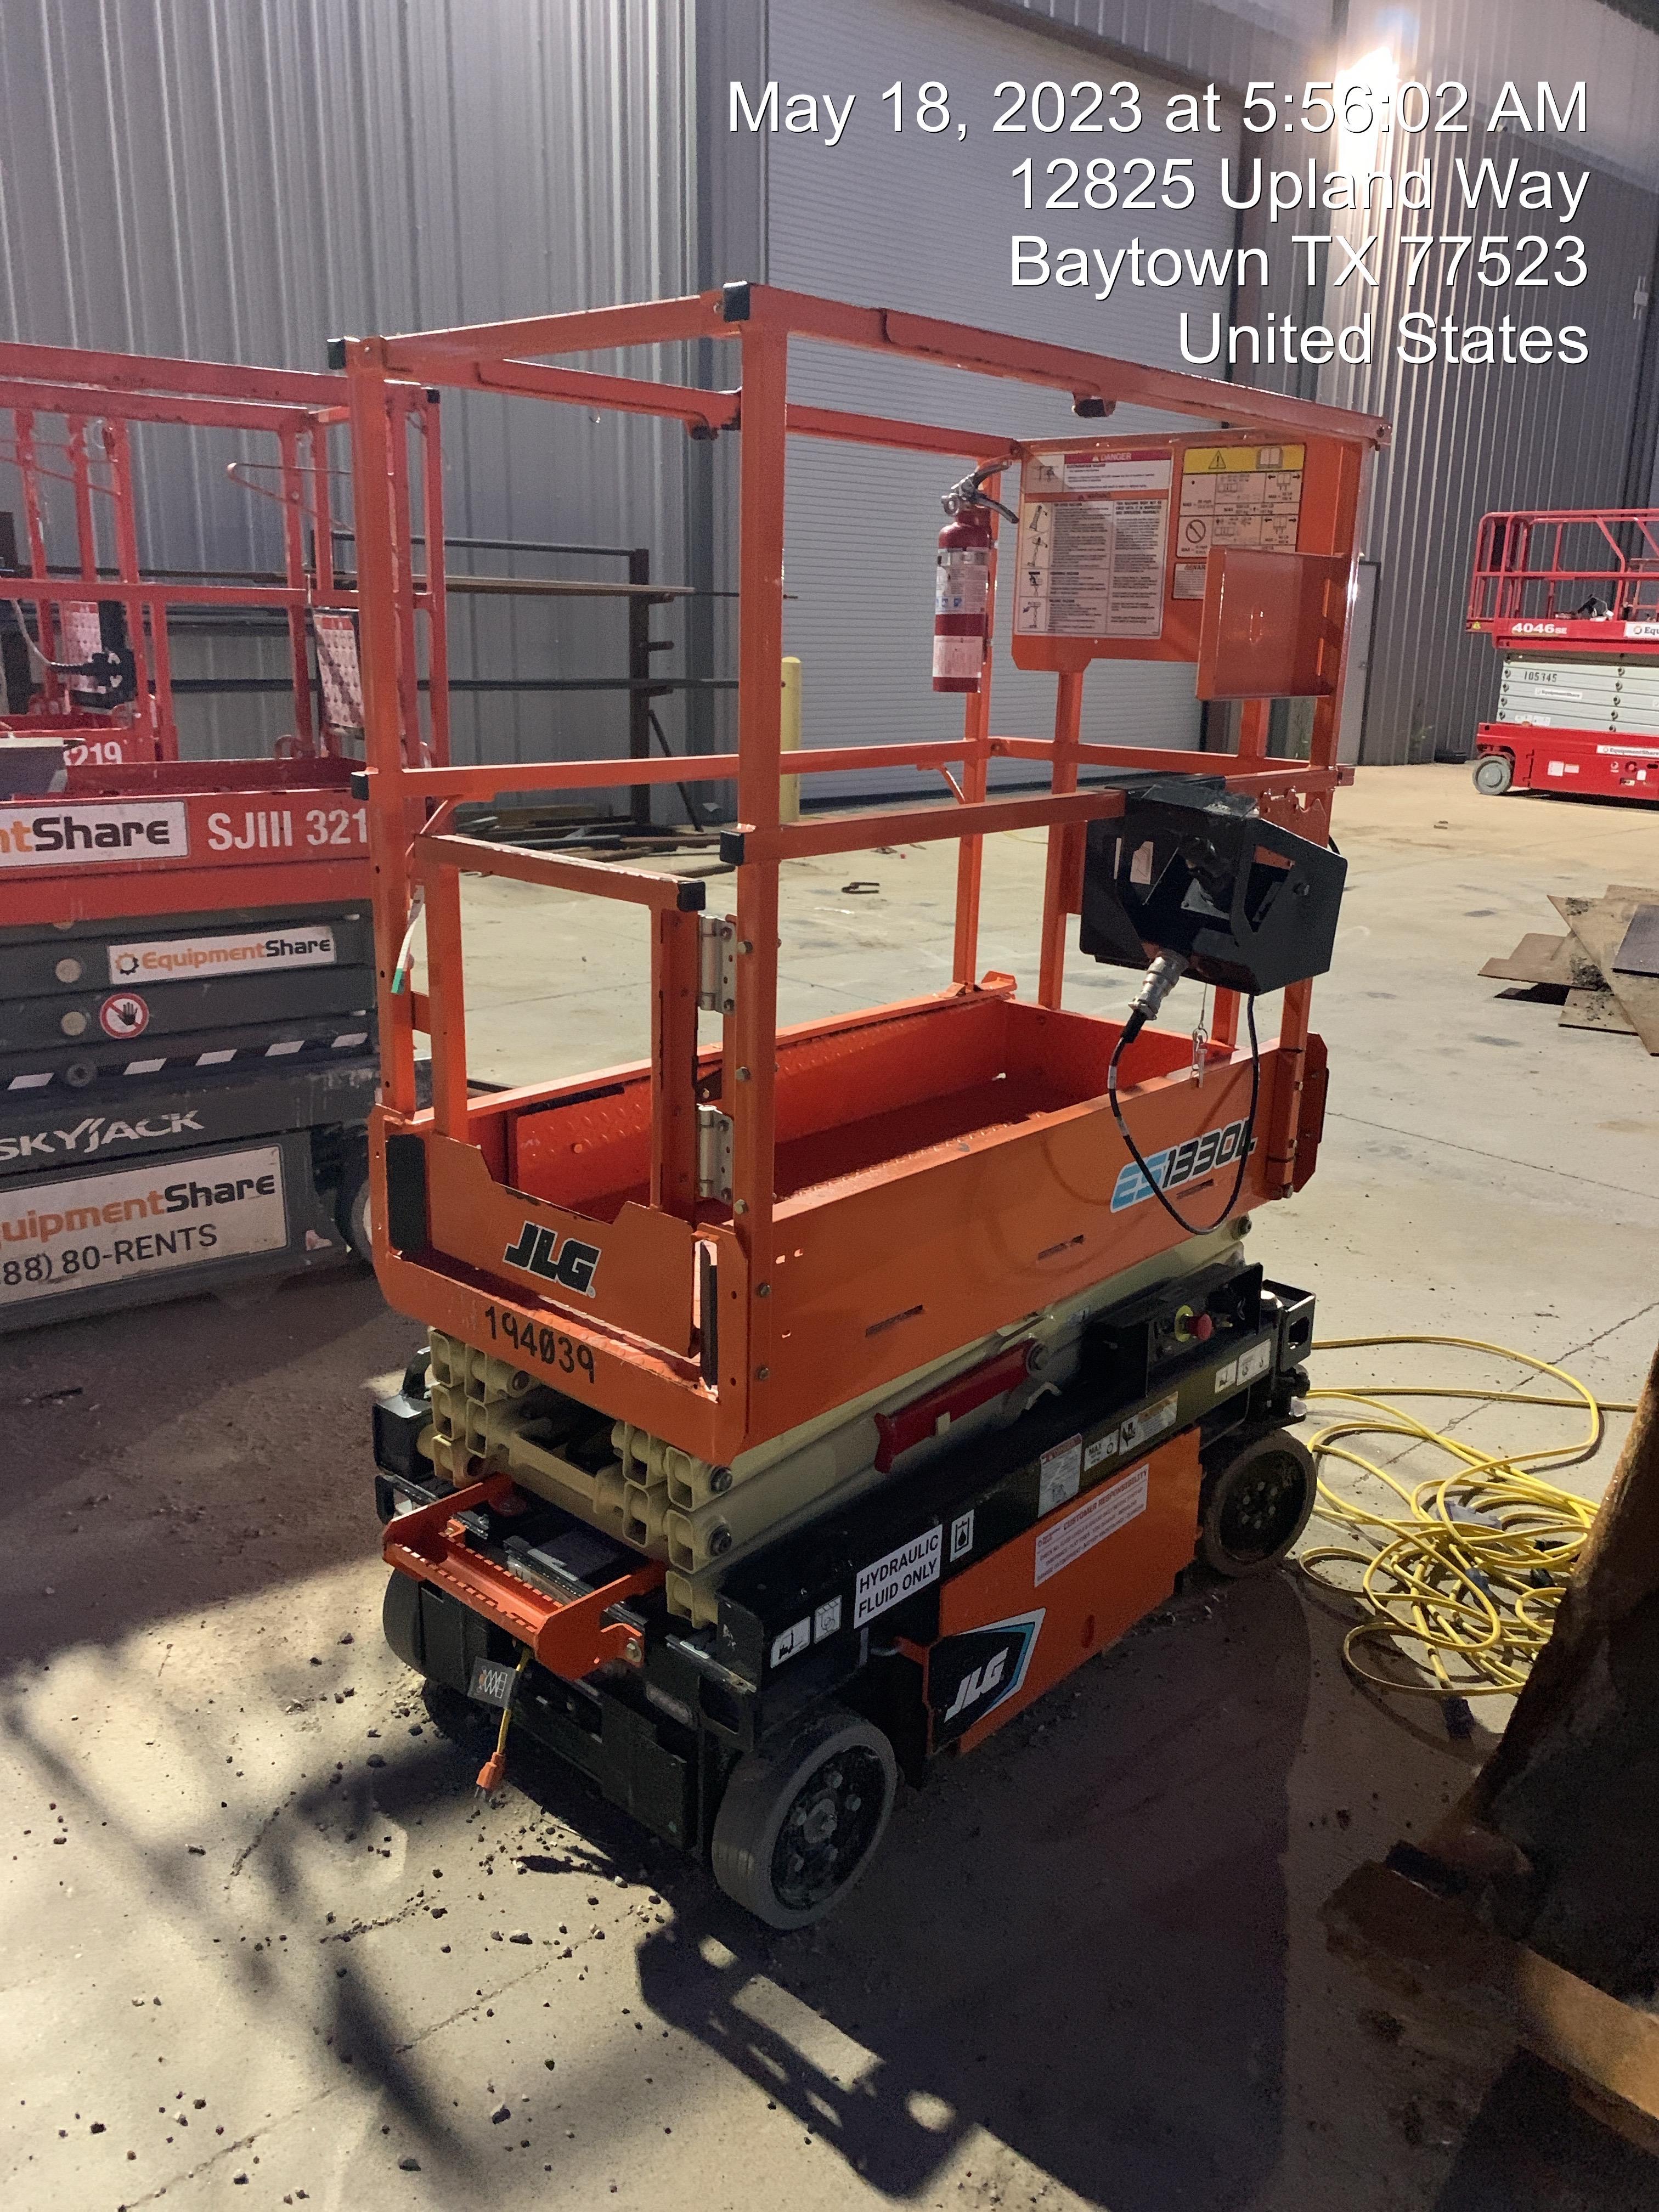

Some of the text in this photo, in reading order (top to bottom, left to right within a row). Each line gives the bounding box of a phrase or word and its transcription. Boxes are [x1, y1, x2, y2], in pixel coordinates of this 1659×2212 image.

[1101, 453, 1132, 461] DANGER
[306, 808, 368, 845] 321
[142, 939, 330, 972] EquipmentShare
[0, 1174, 275, 1244] uipmentShare
[0, 1223, 217, 1285] 88) 80-RENTS
[503, 1220, 602, 1296] JLG
[485, 1306, 595, 1384] 194039
[1063, 1502, 1097, 1531] CUSTOMER
[1098, 1470, 1147, 1506] RESPONSIBILITY
[859, 1558, 937, 1618] FLUID ONLY
[860, 1534, 939, 1594] HYDRAULIC
[944, 1647, 1009, 1723] JLG
